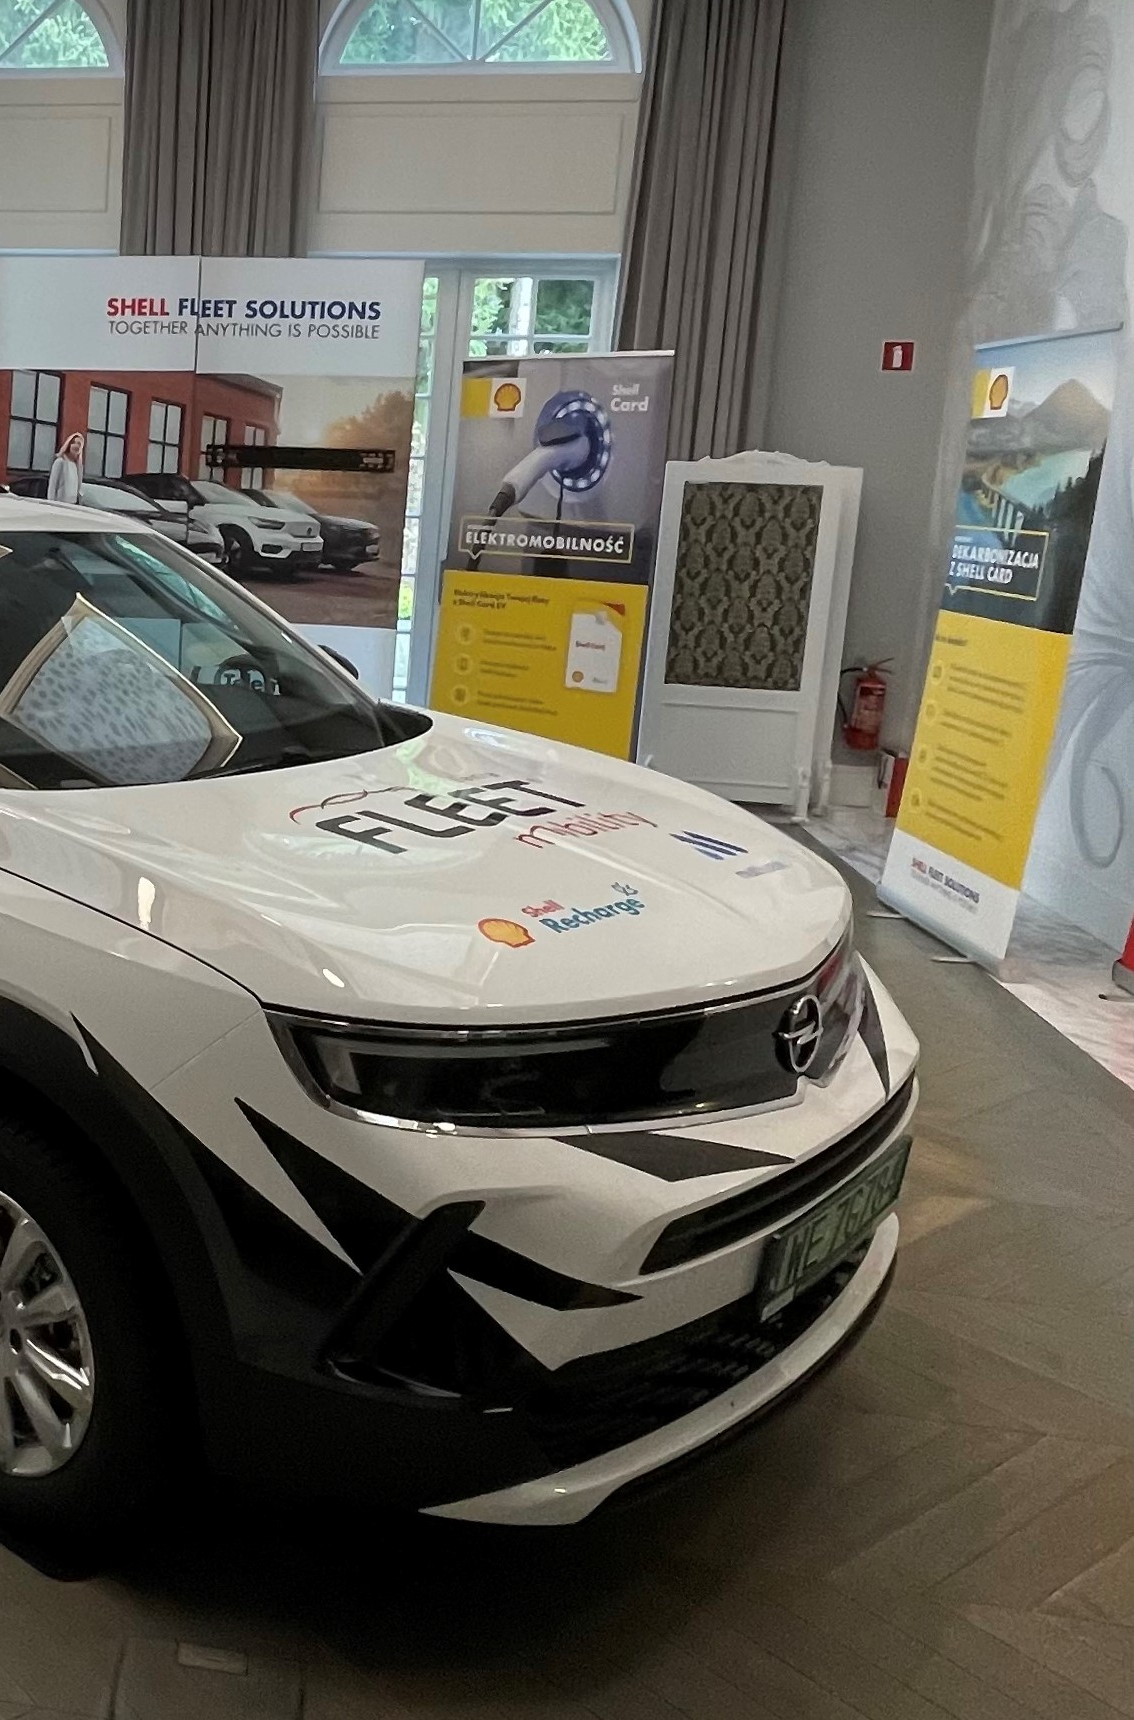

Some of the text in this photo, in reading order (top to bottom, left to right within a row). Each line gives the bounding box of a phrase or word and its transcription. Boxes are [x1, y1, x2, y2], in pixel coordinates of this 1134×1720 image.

[106, 298, 381, 320] SHELL FLEET SOLUTIONS
[108, 320, 380, 339] TOGETHER ANYTHING IS POSSIBLE
[612, 383, 640, 396] Shell
[610, 396, 649, 412] Card
[465, 531, 625, 554] ELEKTROMOBILNOŚĆ
[951, 544, 1039, 569] DEKARBONIZACJA
[949, 561, 1013, 584] Z SHELL CARD
[316, 780, 586, 855] FLEET
[514, 811, 659, 850] mobility
[522, 899, 565, 918] Shell
[539, 897, 645, 934] Recharge
